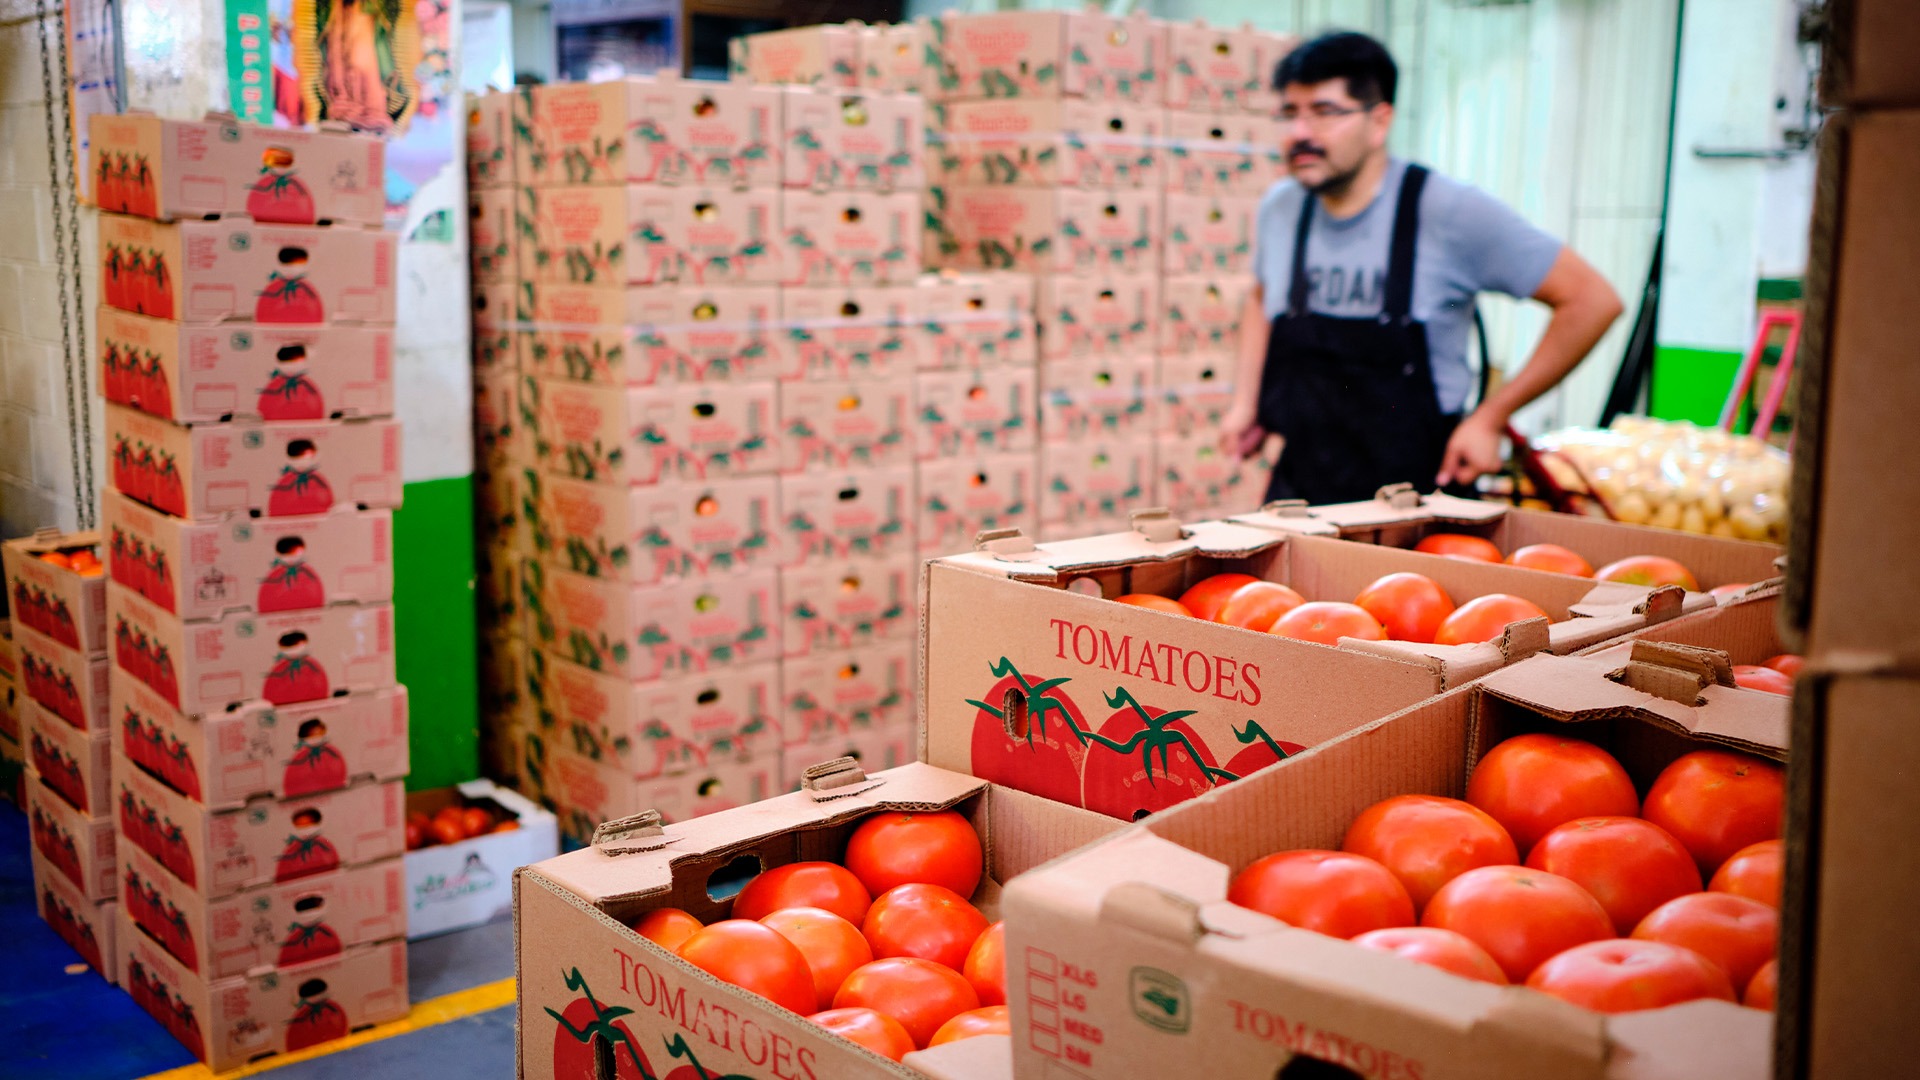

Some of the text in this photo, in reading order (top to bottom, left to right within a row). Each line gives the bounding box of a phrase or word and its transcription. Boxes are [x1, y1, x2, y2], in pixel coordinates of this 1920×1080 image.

[1050, 618, 1262, 706] TOMATOES
[1062, 962, 1098, 988] XLG
[613, 948, 818, 1080] TOMATOES
[1062, 989, 1087, 1012] LG
[1063, 1018, 1104, 1045] MED
[1226, 999, 1424, 1080] TOMATOES
[1065, 1045, 1092, 1068] SM
